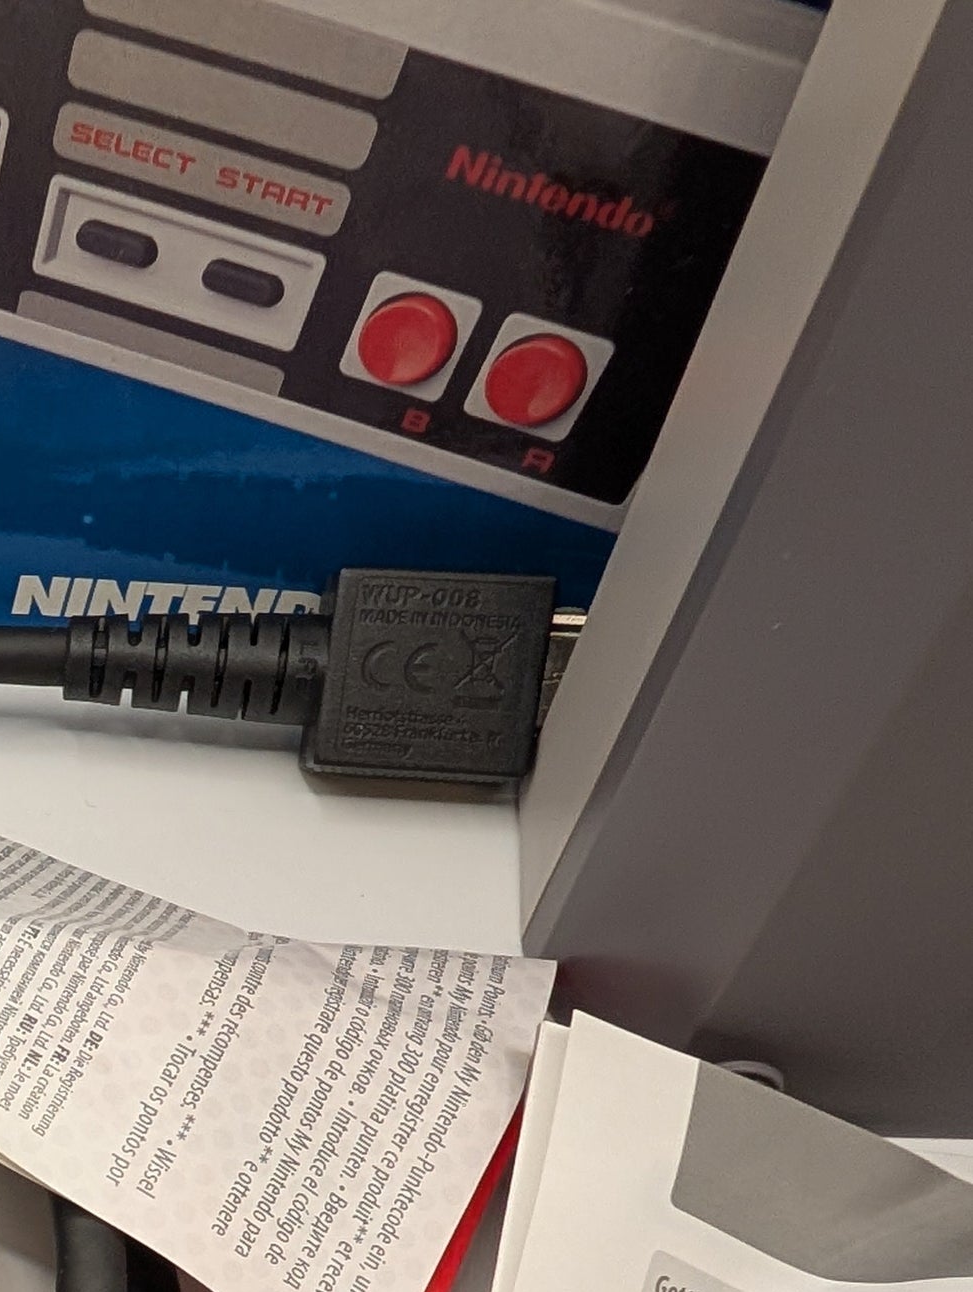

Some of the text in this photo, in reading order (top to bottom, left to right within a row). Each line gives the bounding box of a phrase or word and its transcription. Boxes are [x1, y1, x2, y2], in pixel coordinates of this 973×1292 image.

[71, 122, 334, 217] SELECT START
[446, 145, 654, 239] Nintendo
[402, 409, 429, 434] B
[524, 448, 555, 475] A
[11, 574, 322, 623] NINTEND
[359, 608, 410, 625] MADE
[37, 977, 58, 992] Co.,
[53, 971, 87, 1014] Nintendo
[90, 976, 109, 996] Ltd
[28, 994, 49, 1014] Ltd.
[103, 994, 123, 1008] Co.,
[229, 994, 254, 1019] des
[355, 1008, 369, 1016] o
[17, 1014, 38, 1034] RU:
[41, 1014, 62, 1028] Co.,
[60, 992, 97, 1043] angeboten.
[93, 1011, 114, 1031] Ltd.
[33, 1030, 53, 1050] Ltd.
[83, 1030, 103, 1051] DE:
[336, 1016, 367, 1060] código
[21, 1049, 43, 1070] NL:
[50, 1044, 70, 1065] FR:
[73, 1050, 93, 1068] Die
[290, 1034, 323, 1082] questo
[398, 1044, 423, 1074] 300
[431, 1038, 453, 1074] pour
[467, 1041, 489, 1063] den
[14, 1068, 31, 1082] Je
[43, 1064, 60, 1077] La
[324, 1060, 346, 1080] de
[349, 1049, 383, 1094] очков.
[454, 1062, 481, 1087] My
[19, 1077, 48, 1120] création
[32, 1066, 83, 1136] Registrierung
[300, 1077, 333, 1130] pontos
[370, 1068, 406, 1124] platina
[106, 1044, 197, 1186] Trocar os pontos por
[391, 1073, 439, 1152] enregistrer
[285, 1128, 312, 1156] My
[340, 1121, 378, 1178] punten.
[137, 1148, 177, 1199] Wissel
[244, 1161, 257, 1172] e
[377, 1085, 471, 1244] Nintendo-Punktecode
[381, 1151, 398, 1169] ce
[253, 1153, 300, 1222] Nintendo
[265, 1108, 357, 1264] Introduce el código de
[211, 1172, 251, 1236] ottenere
[235, 1218, 261, 1257] para
[283, 1192, 347, 1289] Введите код
[335, 1241, 352, 1260] et
[359, 1245, 385, 1270] ein,
